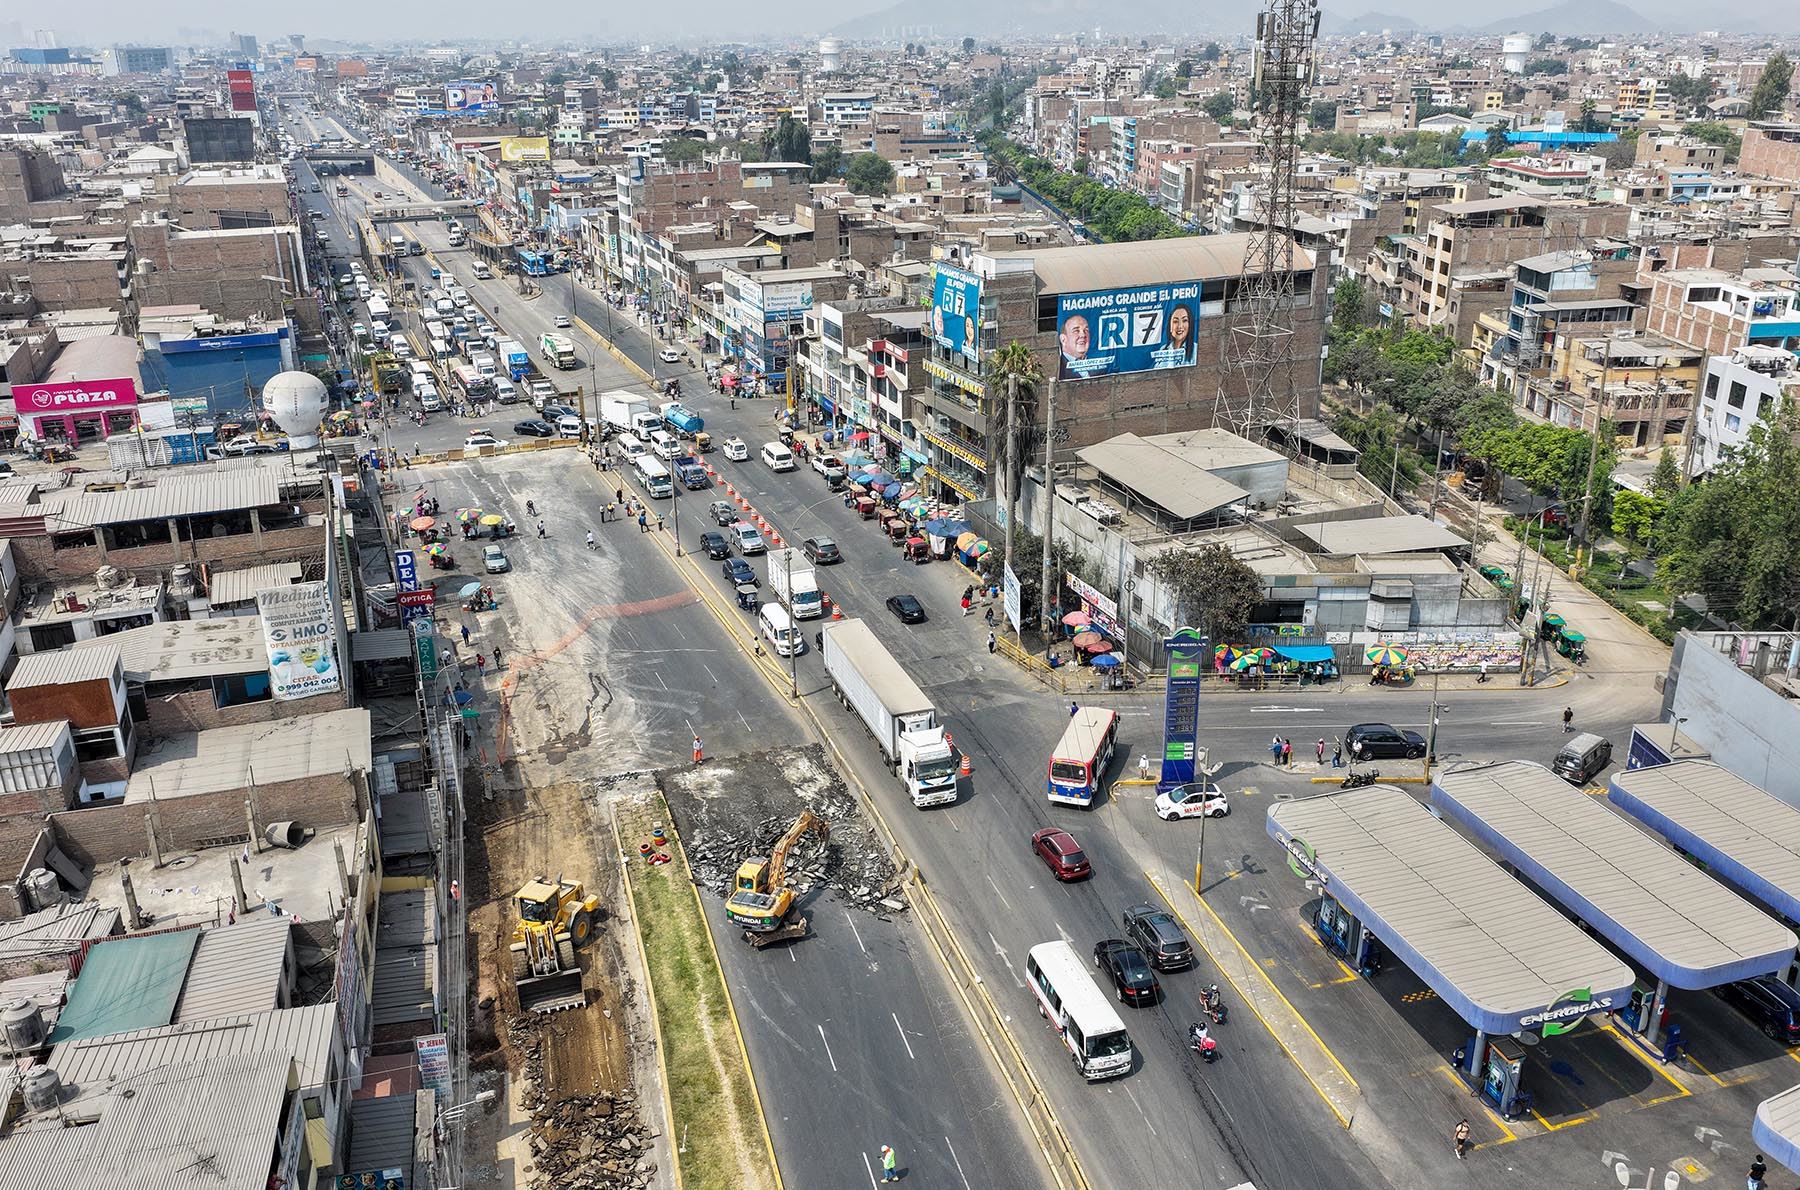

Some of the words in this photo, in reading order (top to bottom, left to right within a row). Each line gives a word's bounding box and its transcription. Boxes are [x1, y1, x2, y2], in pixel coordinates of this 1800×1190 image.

[944, 293, 952, 311] R
[957, 296, 964, 315] 7
[1062, 294, 1113, 311] HAGAMOS
[1115, 291, 1157, 305] GRANDE
[1159, 290, 1171, 301] EL
[1172, 284, 1198, 299] PERÚ
[1101, 315, 1125, 348] R
[1139, 313, 1158, 344] 7
[54, 390, 117, 405] PLAZA
[401, 594, 432, 604] ÓPTICA
[265, 613, 289, 621] MEDIDA
[308, 608, 326, 616] VISTA
[270, 615, 323, 628] COMPUTARIZADA
[293, 622, 328, 639] HMO
[286, 683, 302, 691] 999
[303, 680, 319, 688] 042
[1275, 832, 1329, 884] ENERGIGAS
[733, 914, 761, 925] HYUNDAI
[1520, 997, 1612, 1026] ENERGIGAS
